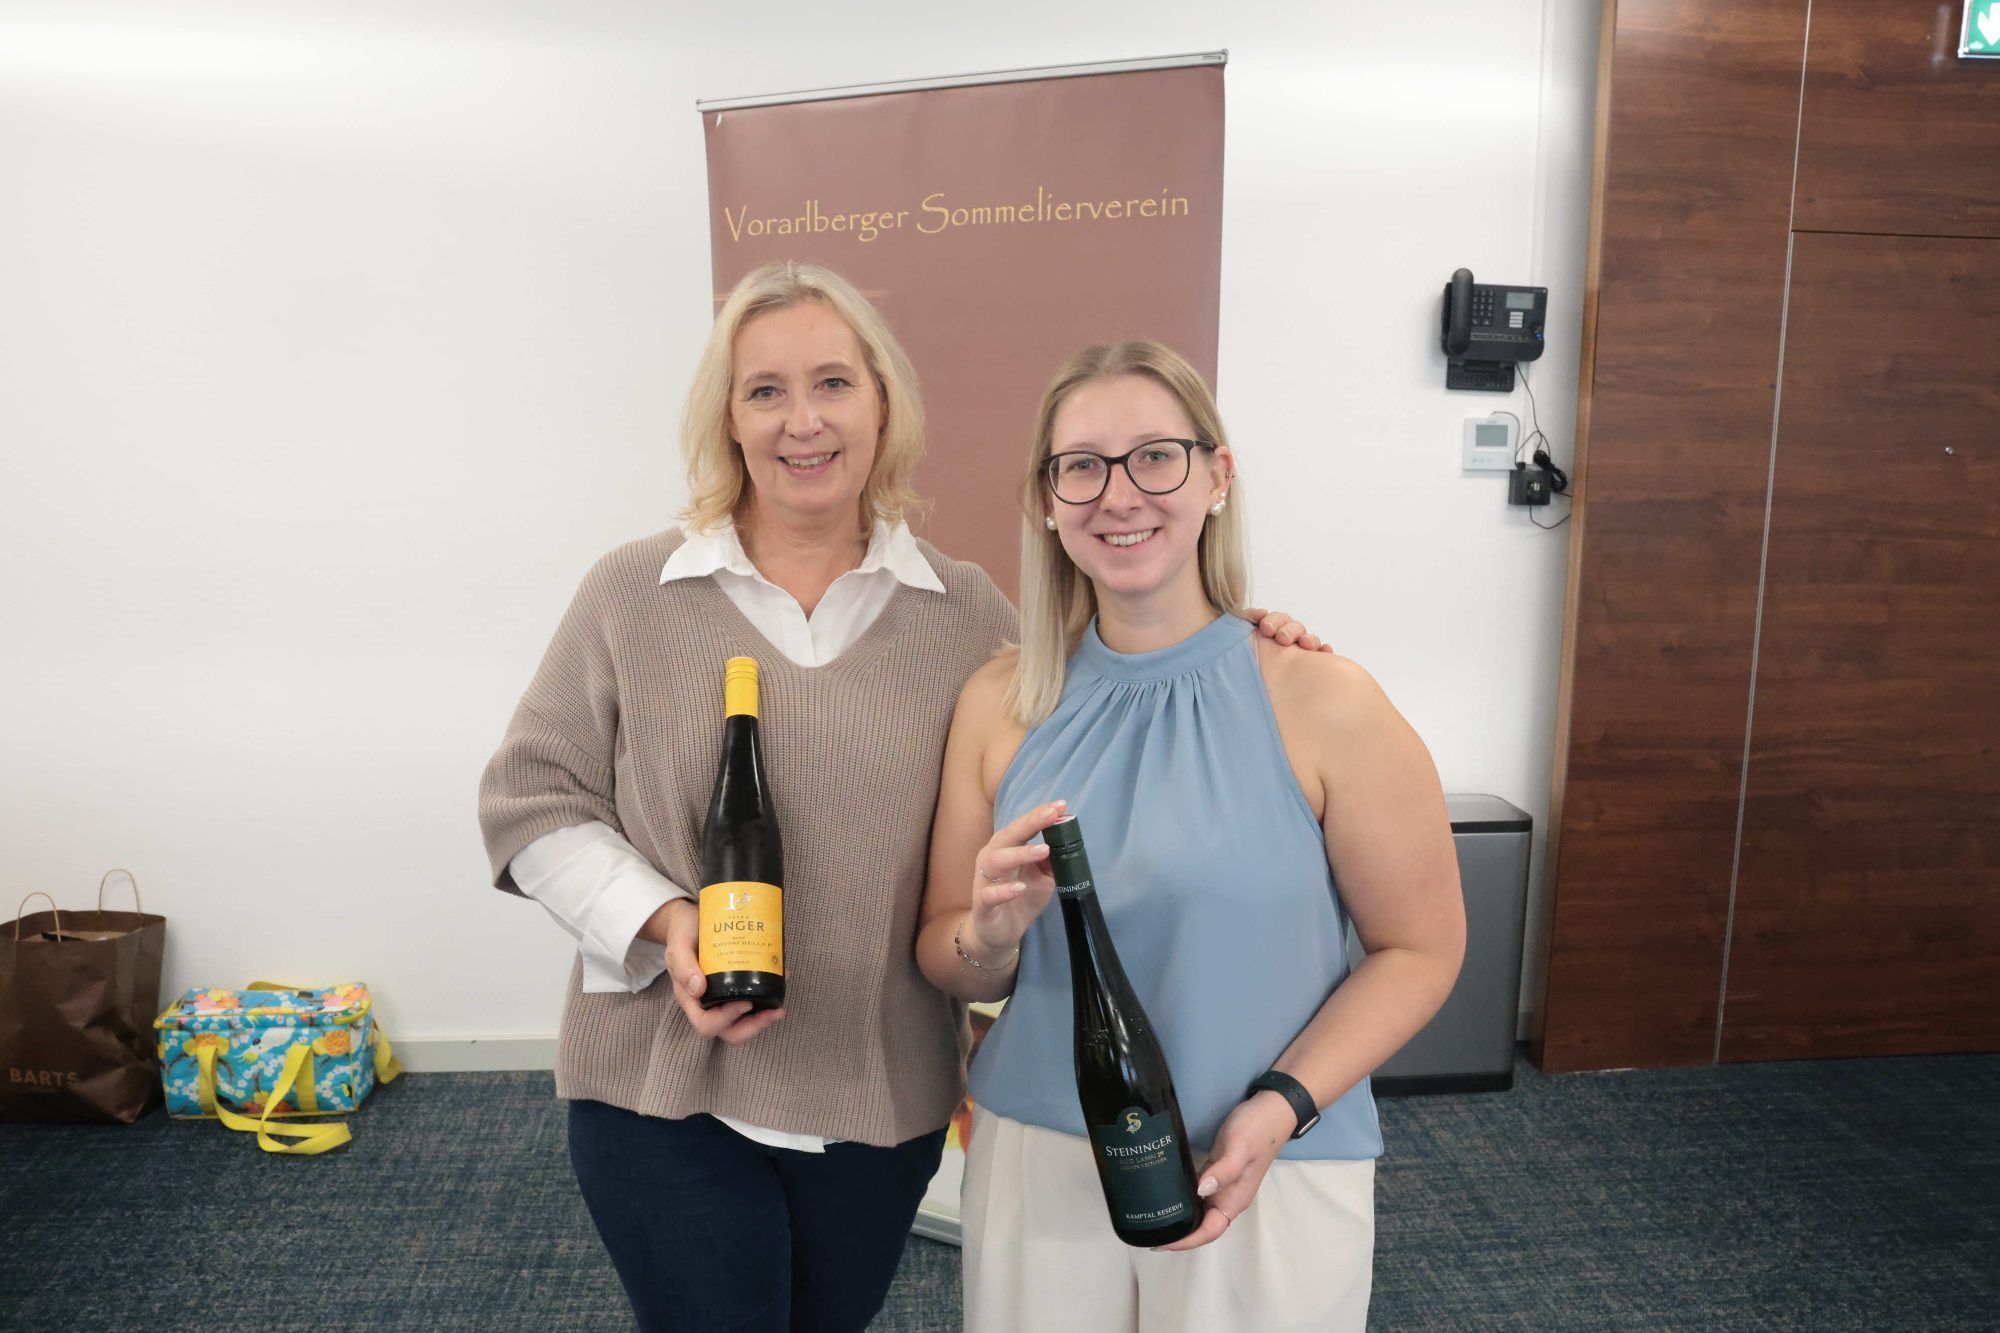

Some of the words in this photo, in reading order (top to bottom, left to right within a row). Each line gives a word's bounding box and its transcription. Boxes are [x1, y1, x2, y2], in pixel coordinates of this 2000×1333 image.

[723, 200, 908, 242] Vorarlberger
[916, 186, 1189, 235] Sommelierverein
[713, 920, 765, 933] UNGER
[9, 1067, 80, 1087] BARTS
[1105, 1135, 1173, 1157] STEININGER
[1157, 1202, 1184, 1217] RESERVE
